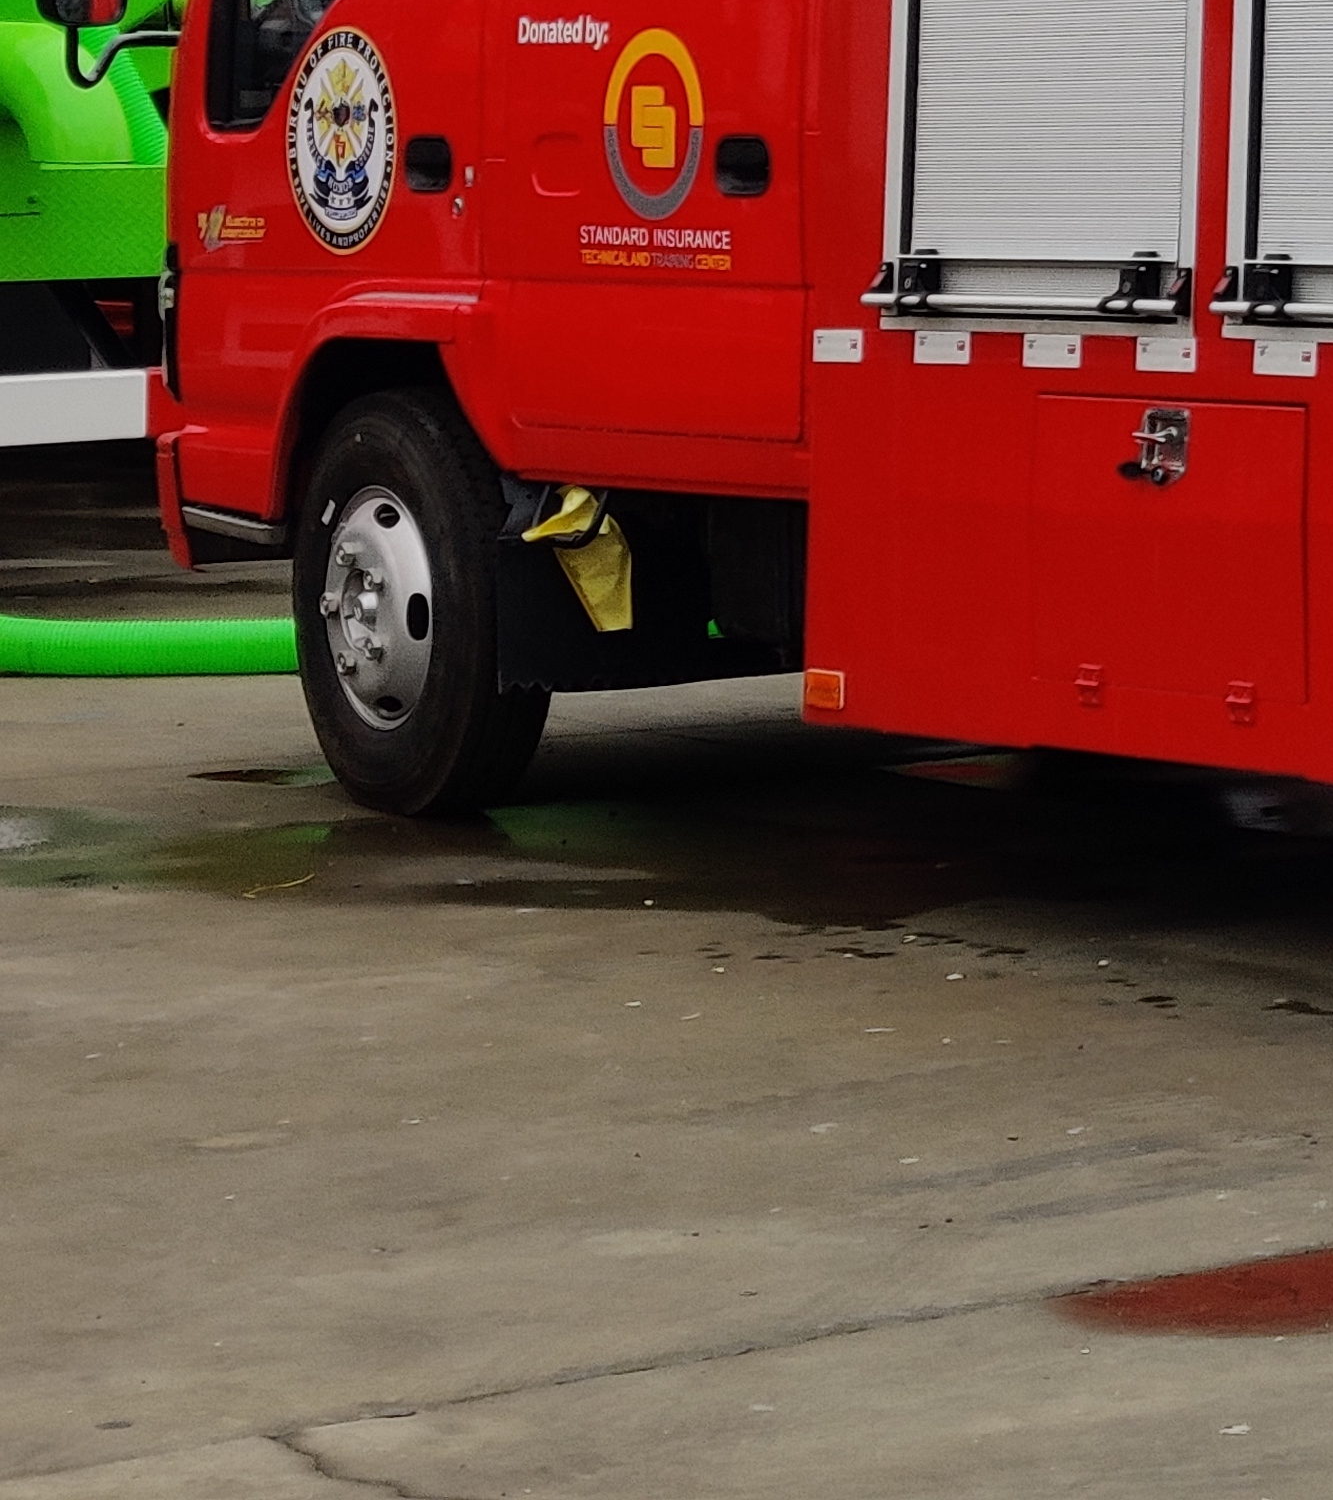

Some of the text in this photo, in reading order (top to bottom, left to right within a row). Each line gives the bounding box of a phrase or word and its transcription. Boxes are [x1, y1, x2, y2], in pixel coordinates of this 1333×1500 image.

[517, 14, 610, 51] Donated by:
[288, 72, 308, 159] BUREAU
[309, 44, 325, 69] OF
[327, 33, 355, 51] FIRE
[357, 37, 394, 162] PROTECTION
[579, 224, 732, 250] STANDARD INSURANCE
